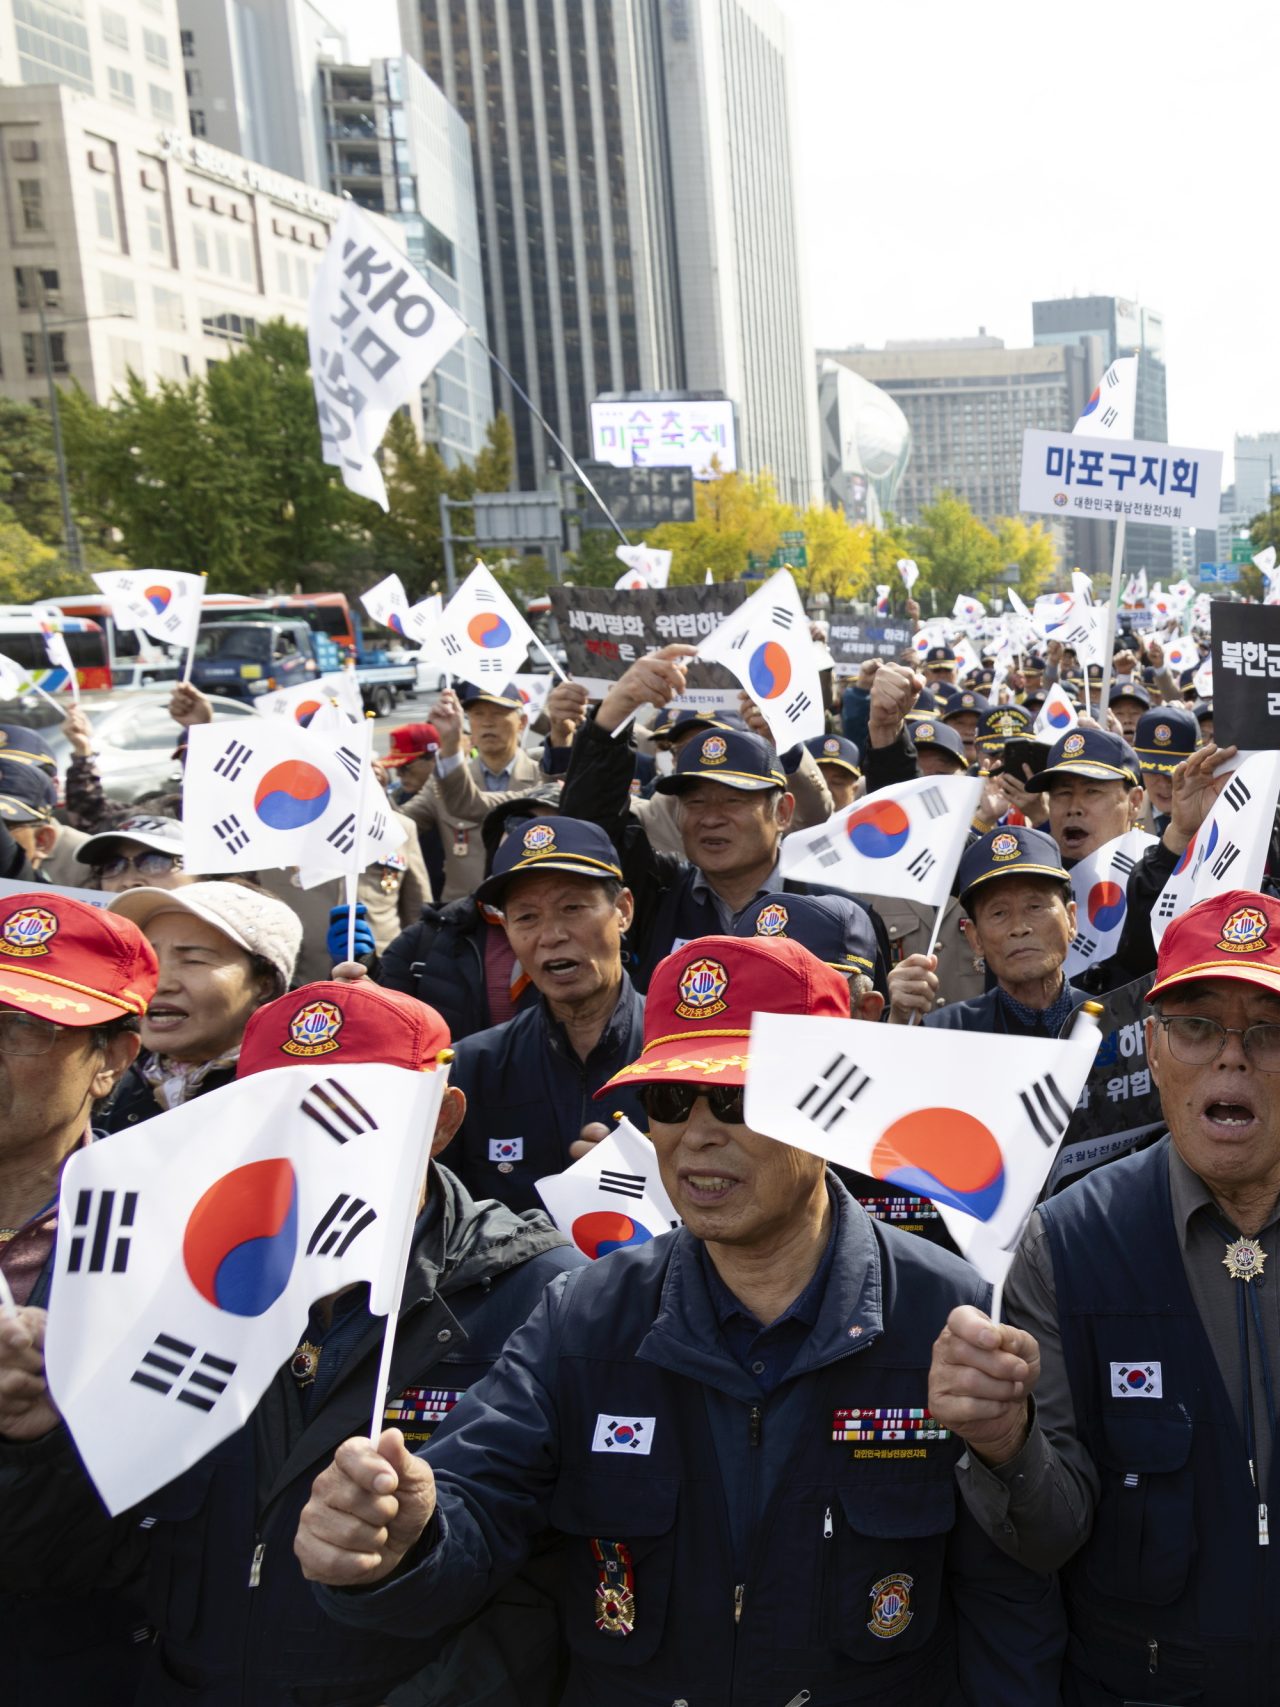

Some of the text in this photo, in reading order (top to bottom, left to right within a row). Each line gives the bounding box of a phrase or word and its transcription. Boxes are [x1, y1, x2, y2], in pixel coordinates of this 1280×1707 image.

[600, 410, 726, 450] 미술축제
[1046, 446, 1199, 498] 마포구지회
[1074, 497, 1183, 519] 대한민국월남전참전자회
[568, 610, 644, 638] 세계평화
[678, 1001, 726, 1018] 국가유공자
[287, 1039, 338, 1054] 국가유공자
[1107, 1068, 1151, 1103] 위협
